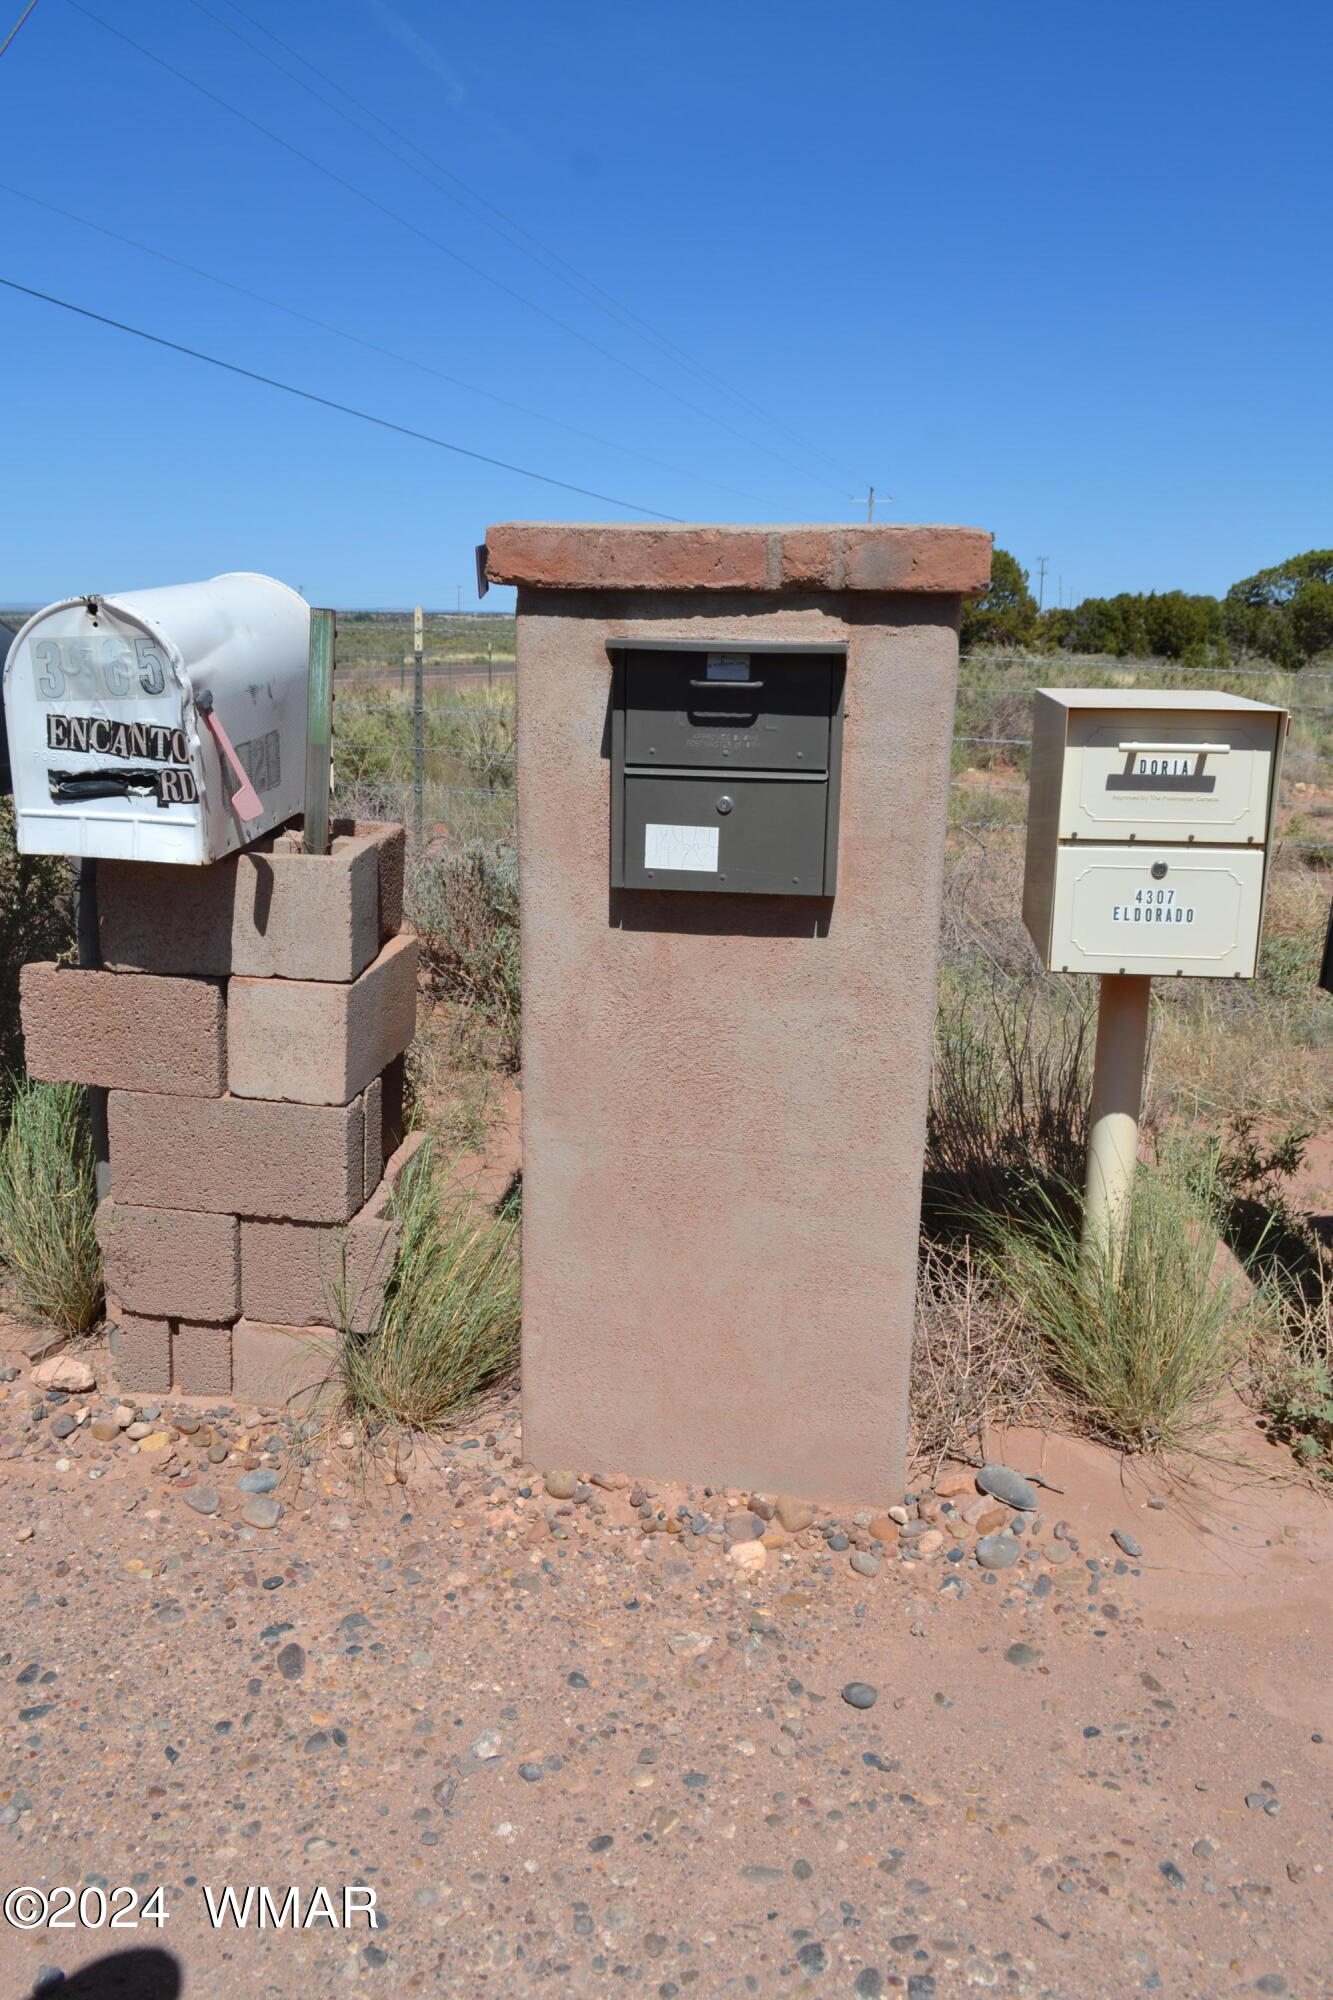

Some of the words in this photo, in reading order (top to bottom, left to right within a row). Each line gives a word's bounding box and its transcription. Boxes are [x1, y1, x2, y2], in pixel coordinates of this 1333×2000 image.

[49, 716, 189, 763] ENCANTO
[1139, 759, 1189, 775] DORIA
[160, 769, 197, 802] RD
[1135, 889, 1175, 905] 4307
[1112, 906, 1194, 923] ELDORADO
